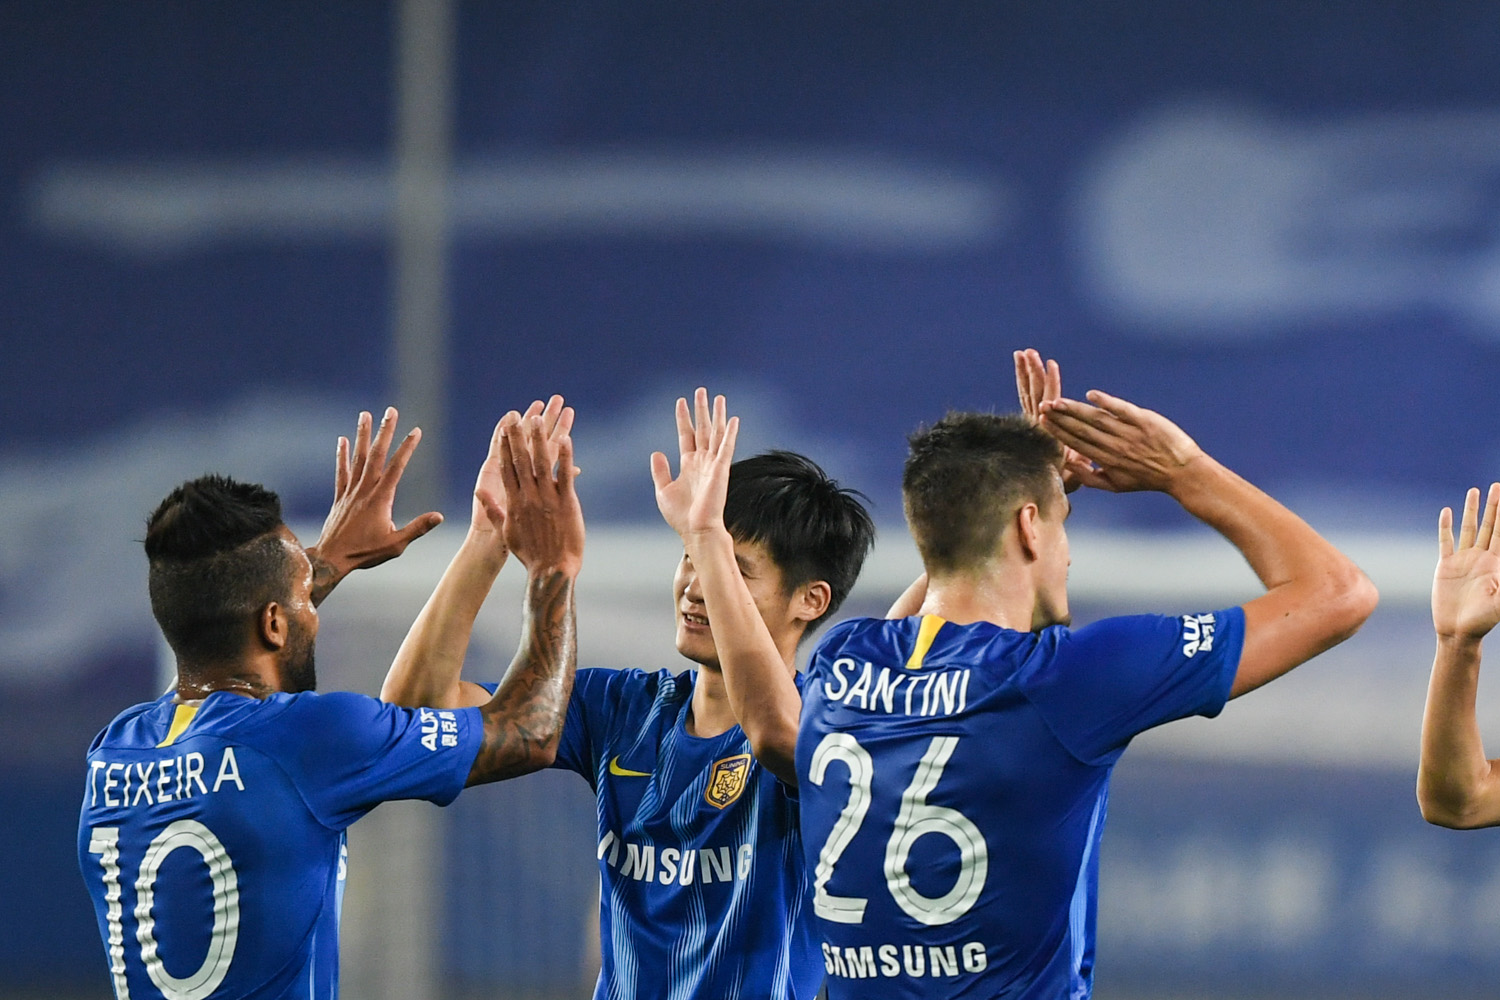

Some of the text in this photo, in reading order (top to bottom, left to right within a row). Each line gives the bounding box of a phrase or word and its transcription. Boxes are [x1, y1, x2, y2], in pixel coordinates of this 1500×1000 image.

[824, 657, 971, 717] SANTINI
[90, 746, 246, 807] TEIXEIRA
[597, 829, 753, 886] AMSUNG
[808, 732, 989, 926] 26
[821, 941, 988, 979] SAMSUNG
